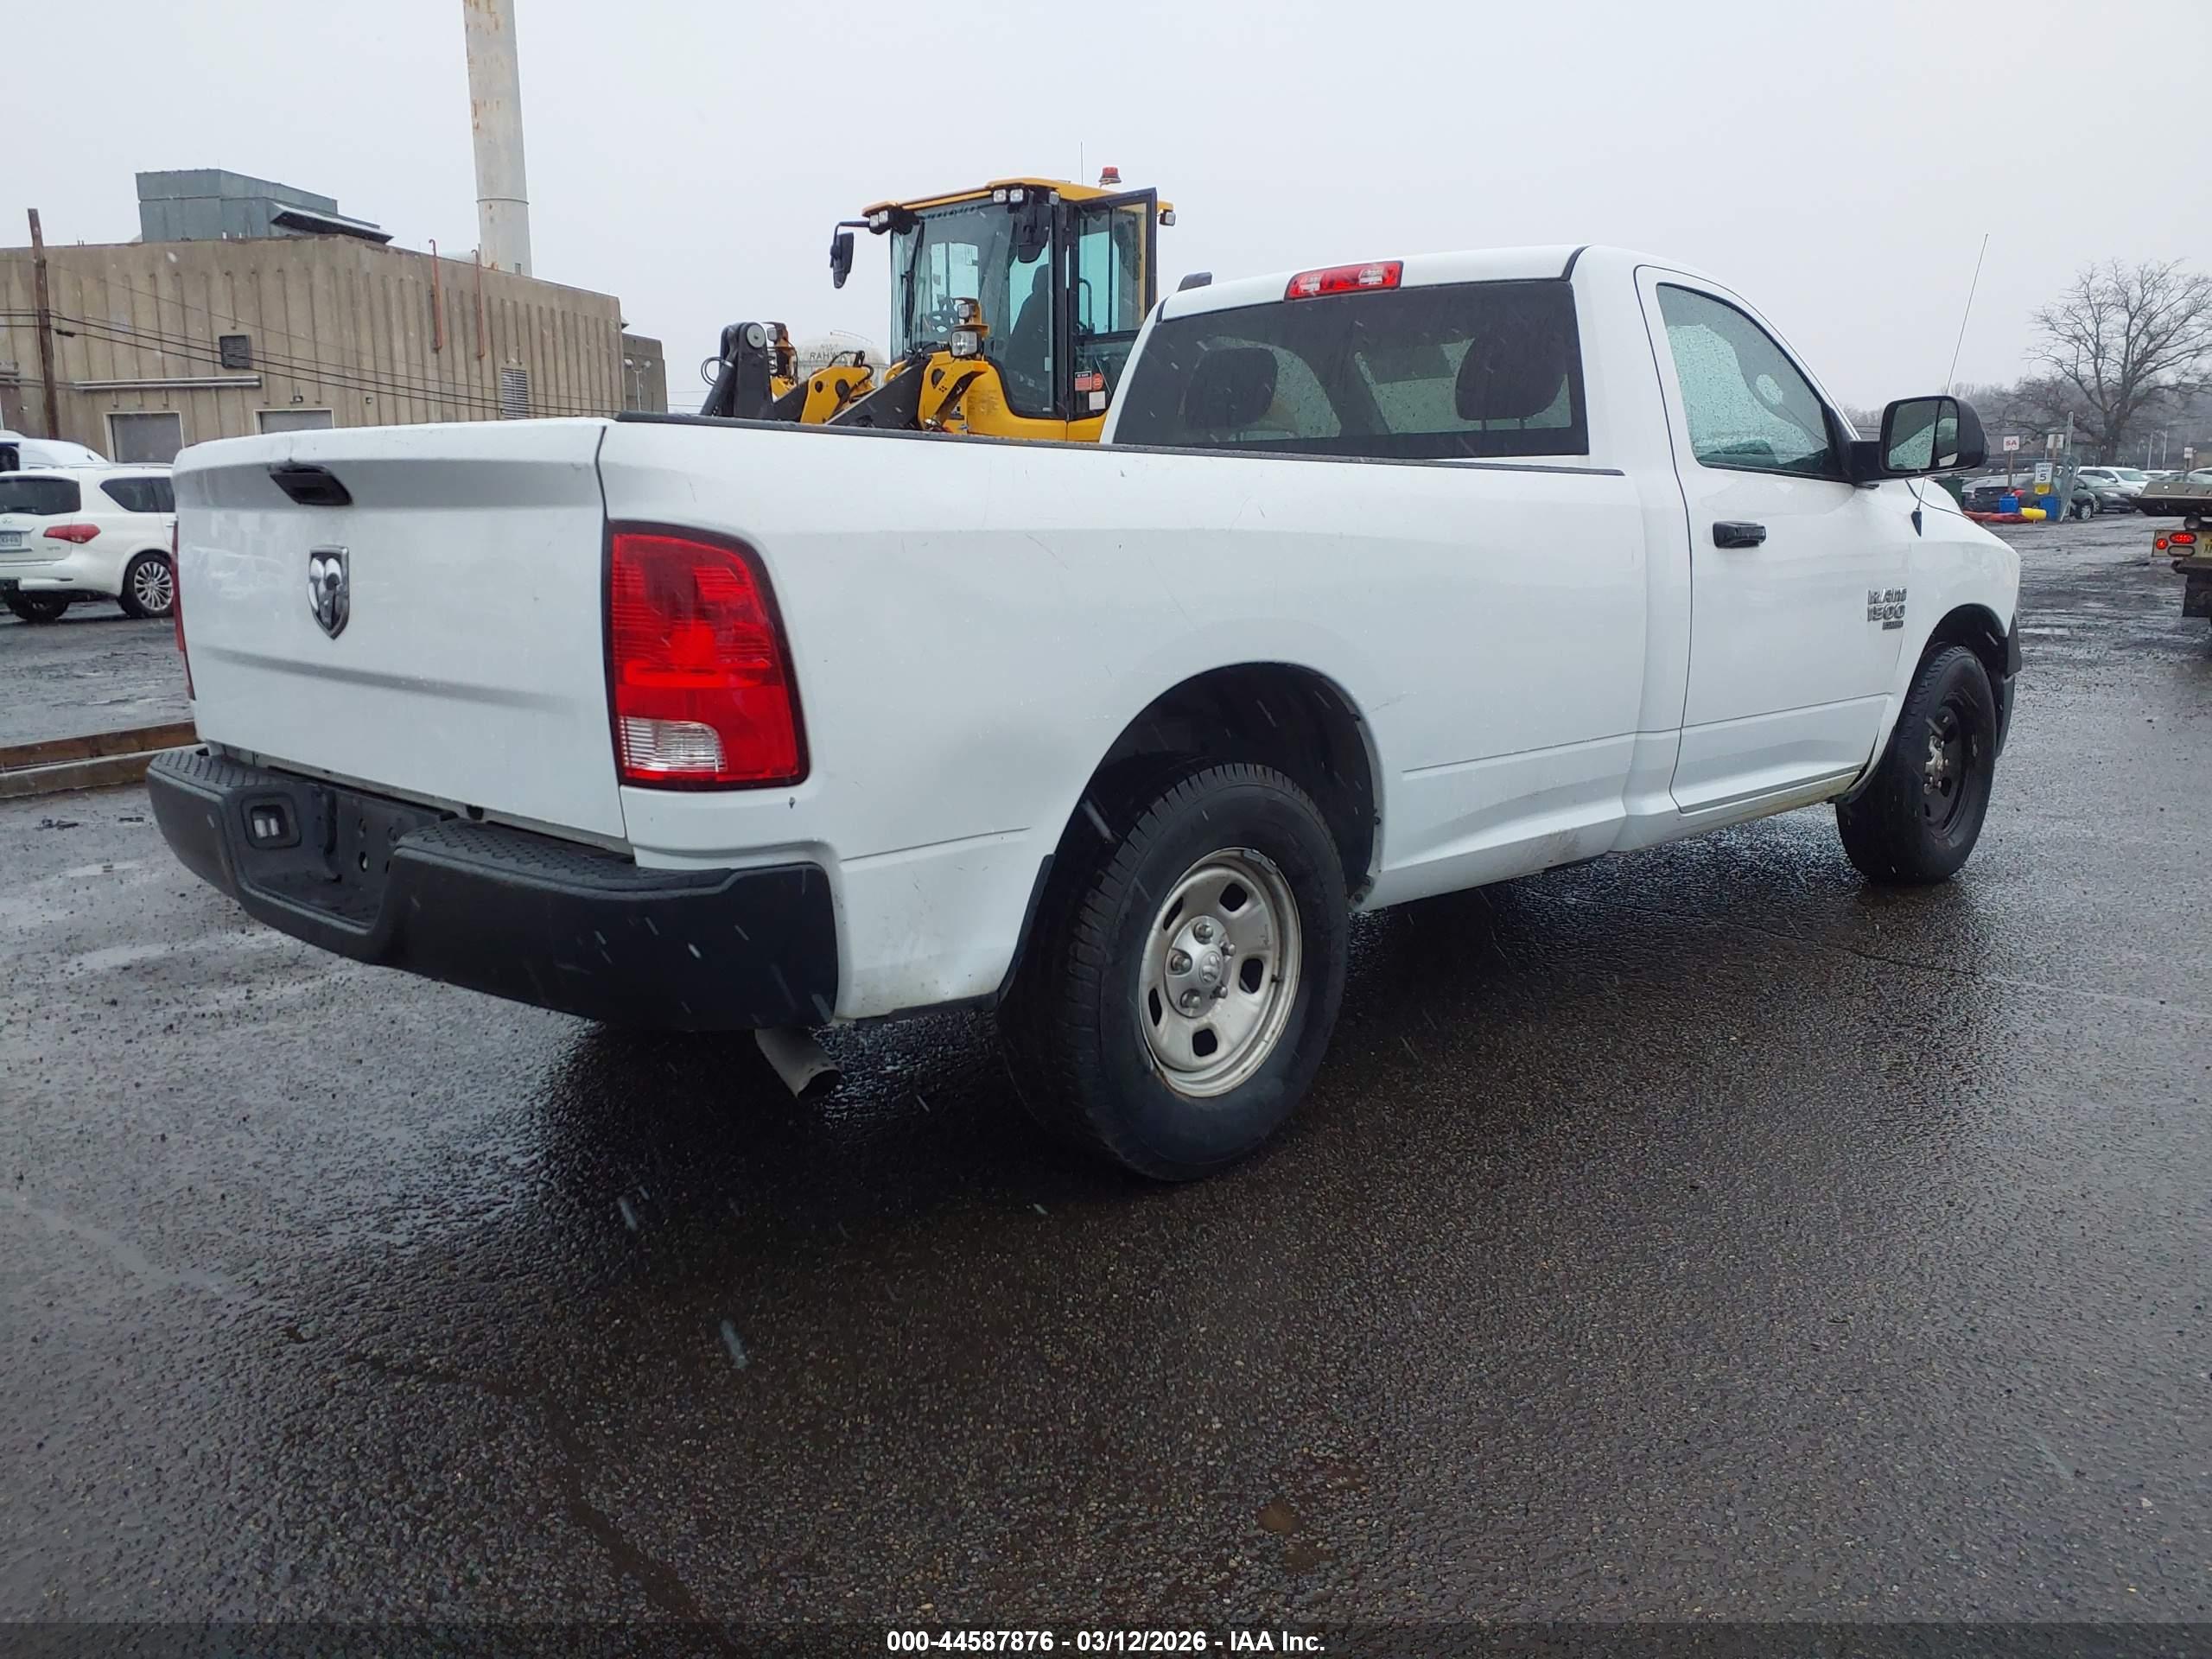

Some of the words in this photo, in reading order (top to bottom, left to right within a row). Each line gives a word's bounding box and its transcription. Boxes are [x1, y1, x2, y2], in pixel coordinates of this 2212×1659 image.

[2039, 473, 2047, 481] 5
[1867, 588, 1907, 605] RAM
[1866, 604, 1906, 622] 1500
